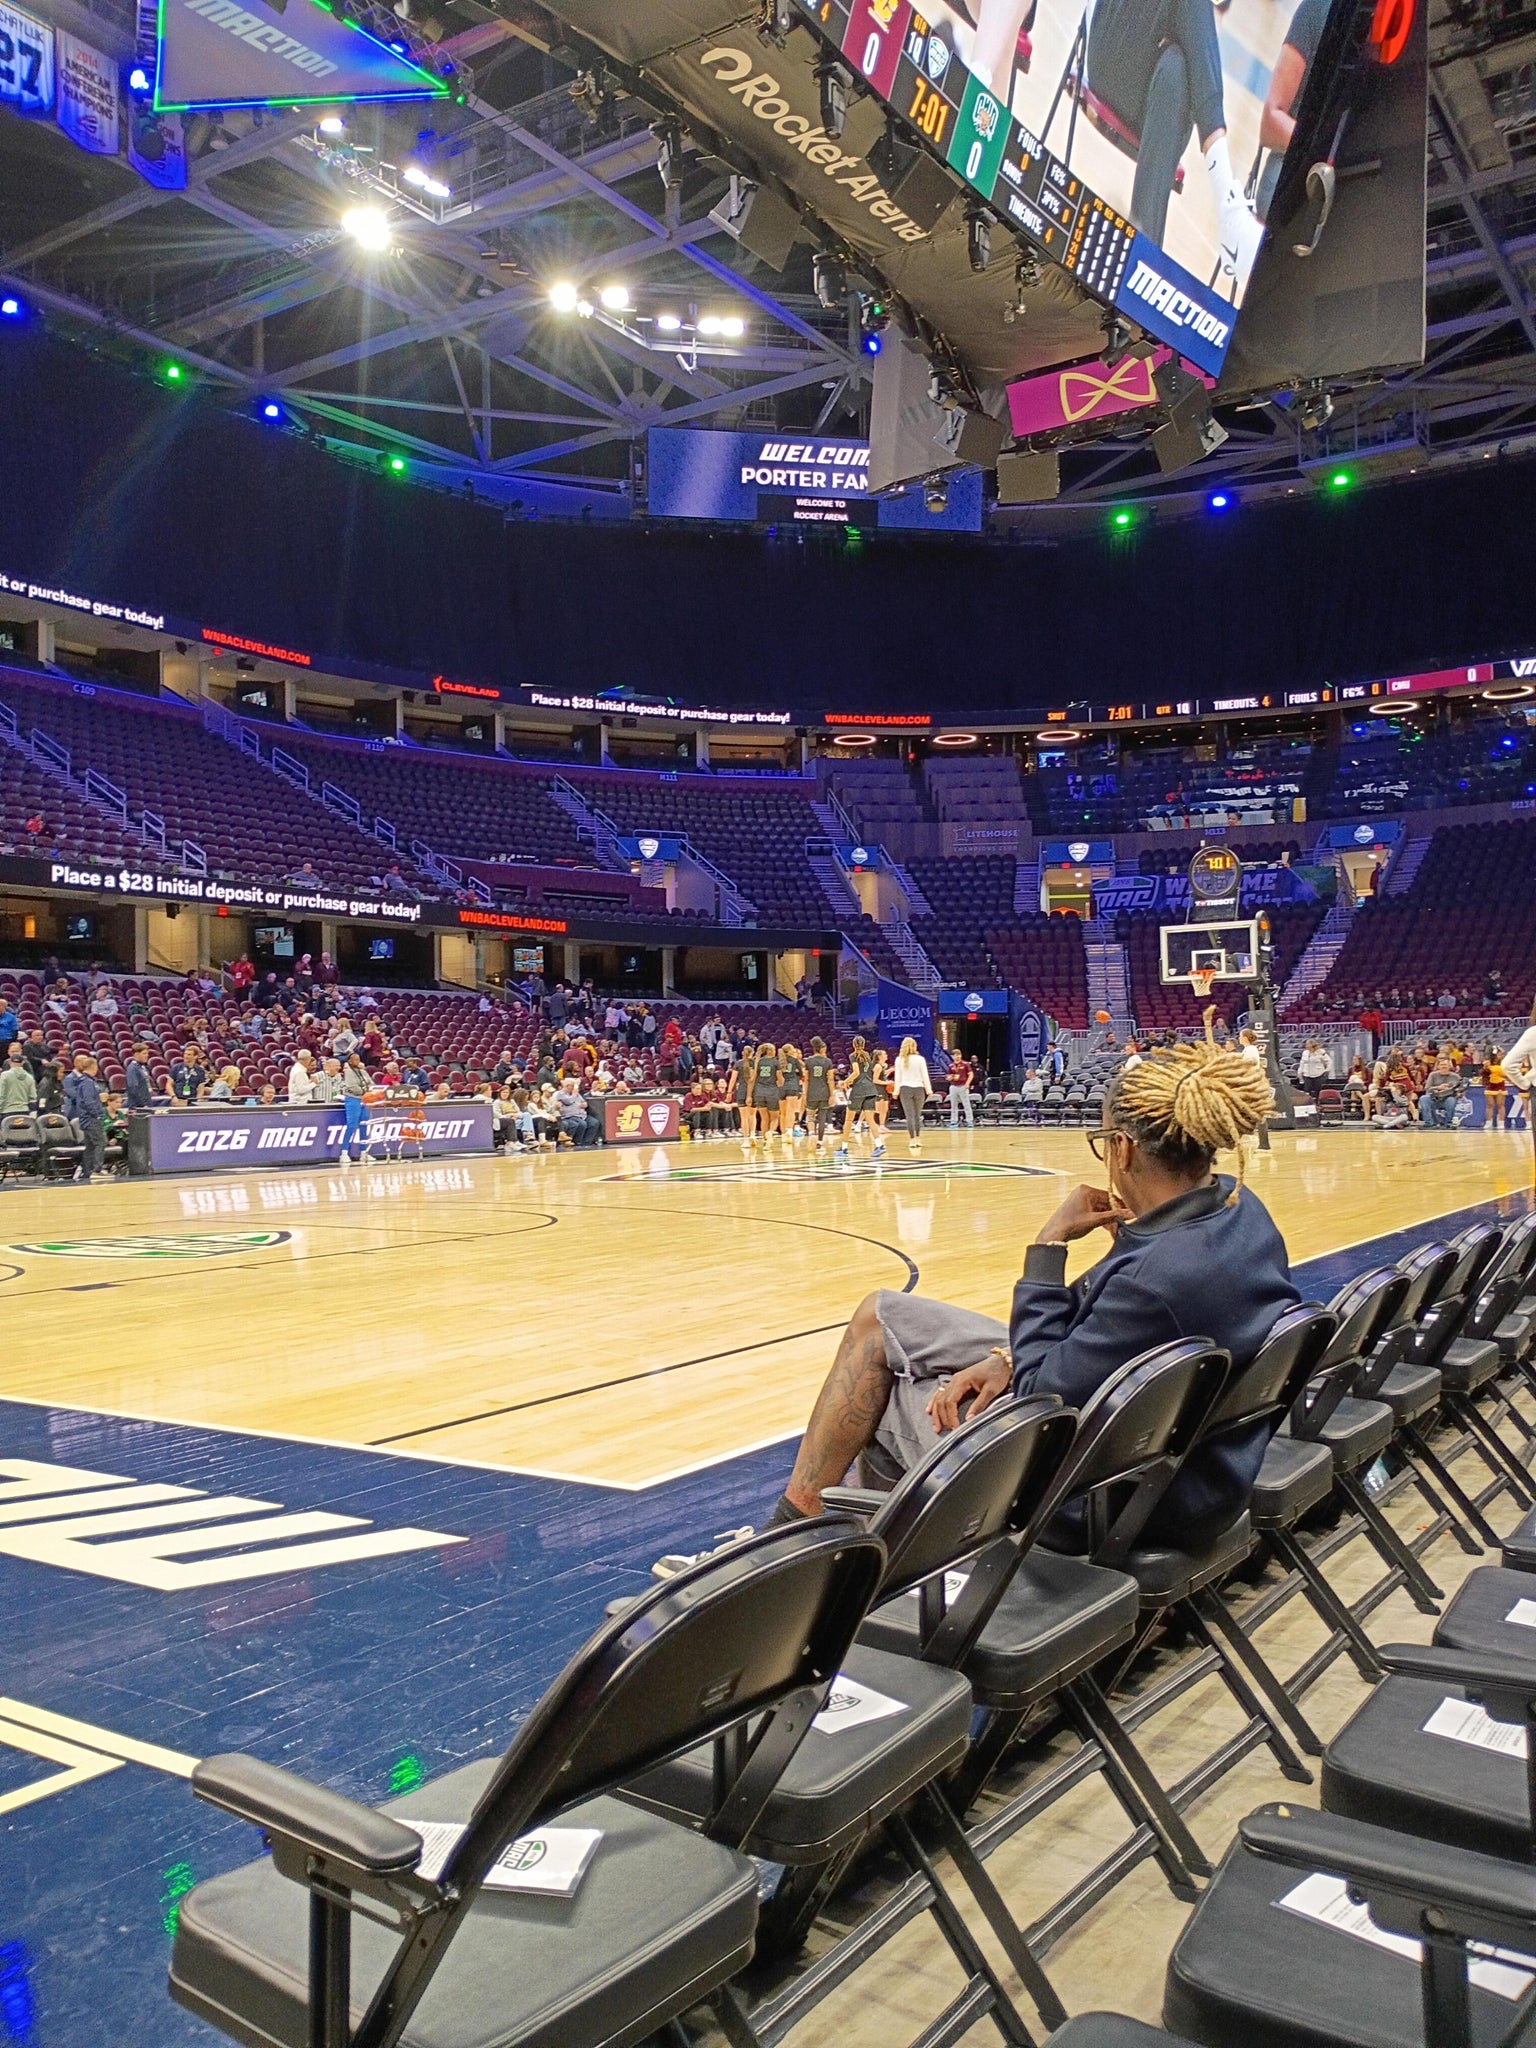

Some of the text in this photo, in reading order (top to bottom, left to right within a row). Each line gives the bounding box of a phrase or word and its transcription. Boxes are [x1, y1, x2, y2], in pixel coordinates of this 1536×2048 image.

[76, 48, 99, 70] 2014
[862, 32, 880, 75] 0
[64, 57, 112, 90] AMERICAN
[60, 68, 116, 108] CONFERENCE
[62, 84, 114, 121] CHAMPIONS
[908, 77, 949, 143] 7:01
[1017, 127, 1042, 160] FOULS
[728, 73, 932, 242] Rocket Arena
[965, 140, 982, 179] 0
[1020, 153, 1030, 171] 0
[1044, 227, 1054, 244] 4
[758, 443, 870, 467] WELCOM
[741, 467, 827, 488] PORTER
[796, 498, 846, 509] WELCOME TO
[793, 511, 849, 522] ROCKET ARENA
[10, 580, 27, 592] or
[28, 583, 91, 610] purchase
[93, 601, 123, 617] gear
[124, 607, 165, 630] today!
[202, 628, 311, 666] WNBACLEVELAND.COM
[1467, 668, 1477, 682] 0
[441, 682, 500, 698] CLEVELAND
[1288, 689, 1331, 704] FOULS 0
[1342, 683, 1380, 698] FG% 0
[531, 693, 791, 725] Place a $28 initial deposit or purchase gear today!
[1107, 706, 1132, 721] 7:01
[1176, 702, 1191, 715] 1Q
[1212, 695, 1271, 711] TIMEOUTS: 4
[824, 713, 932, 725] WNBACLEVELAND.COM
[966, 829, 1019, 838] LITEHOUSE
[51, 864, 422, 922] Place a $28 initial deposit or purchase gear today!
[1095, 890, 1151, 908] MAC
[459, 910, 567, 933] WNBACLEVELAND.COM
[177, 1128, 250, 1153] 2026
[257, 1126, 319, 1149] MAC
